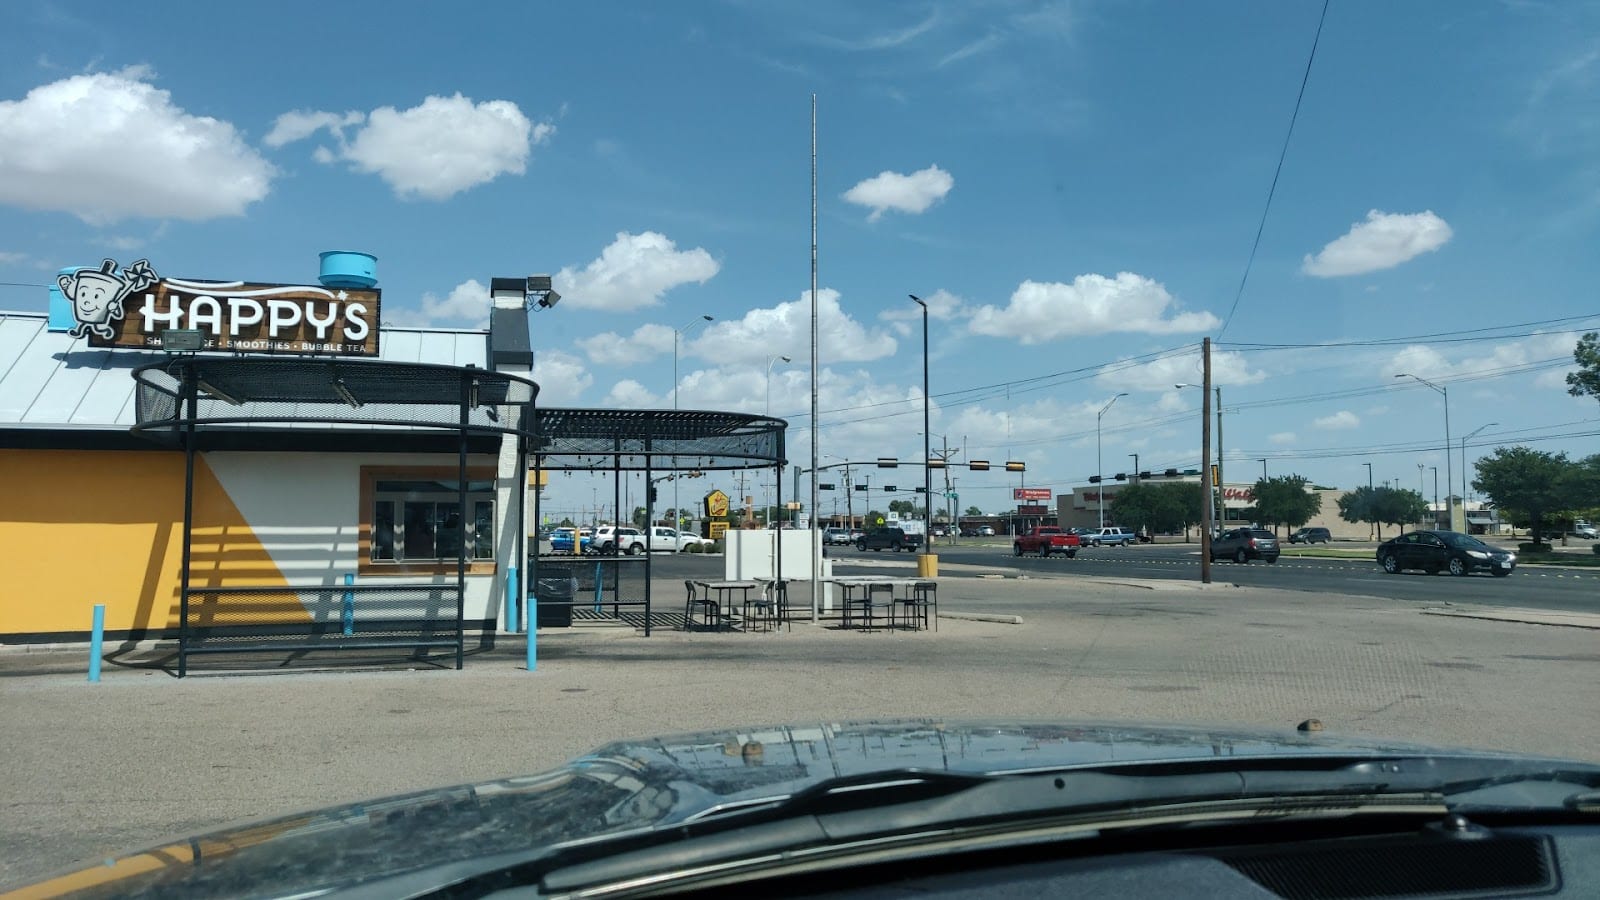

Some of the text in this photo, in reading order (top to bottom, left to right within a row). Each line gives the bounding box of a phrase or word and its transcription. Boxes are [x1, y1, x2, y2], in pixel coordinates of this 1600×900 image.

[227, 340, 290, 350] SMOOTHIES
[301, 342, 343, 352] BUBBLE
[346, 344, 367, 353] TEA
